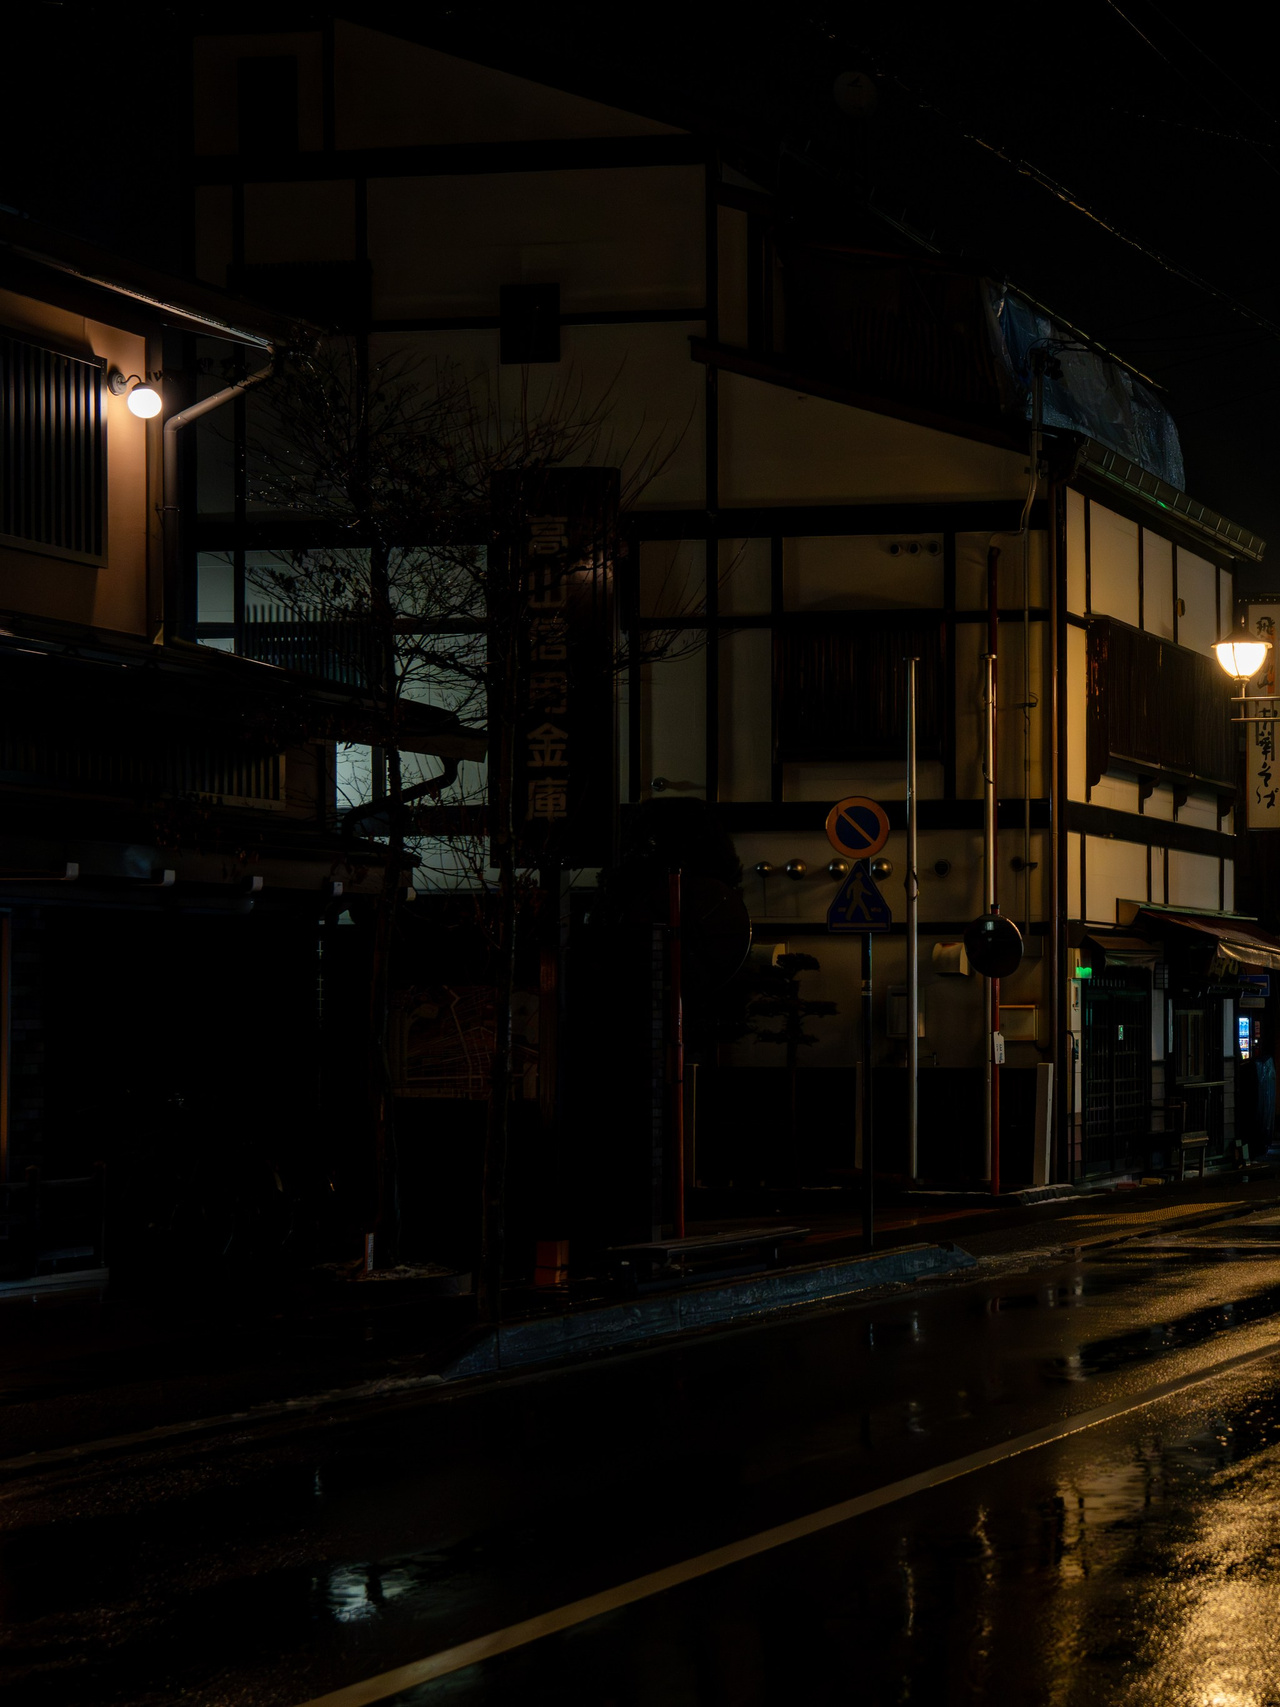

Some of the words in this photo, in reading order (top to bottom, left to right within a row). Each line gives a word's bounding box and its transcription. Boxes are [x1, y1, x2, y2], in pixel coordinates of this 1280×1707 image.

[525, 513, 570, 824] 高山信用金庫
